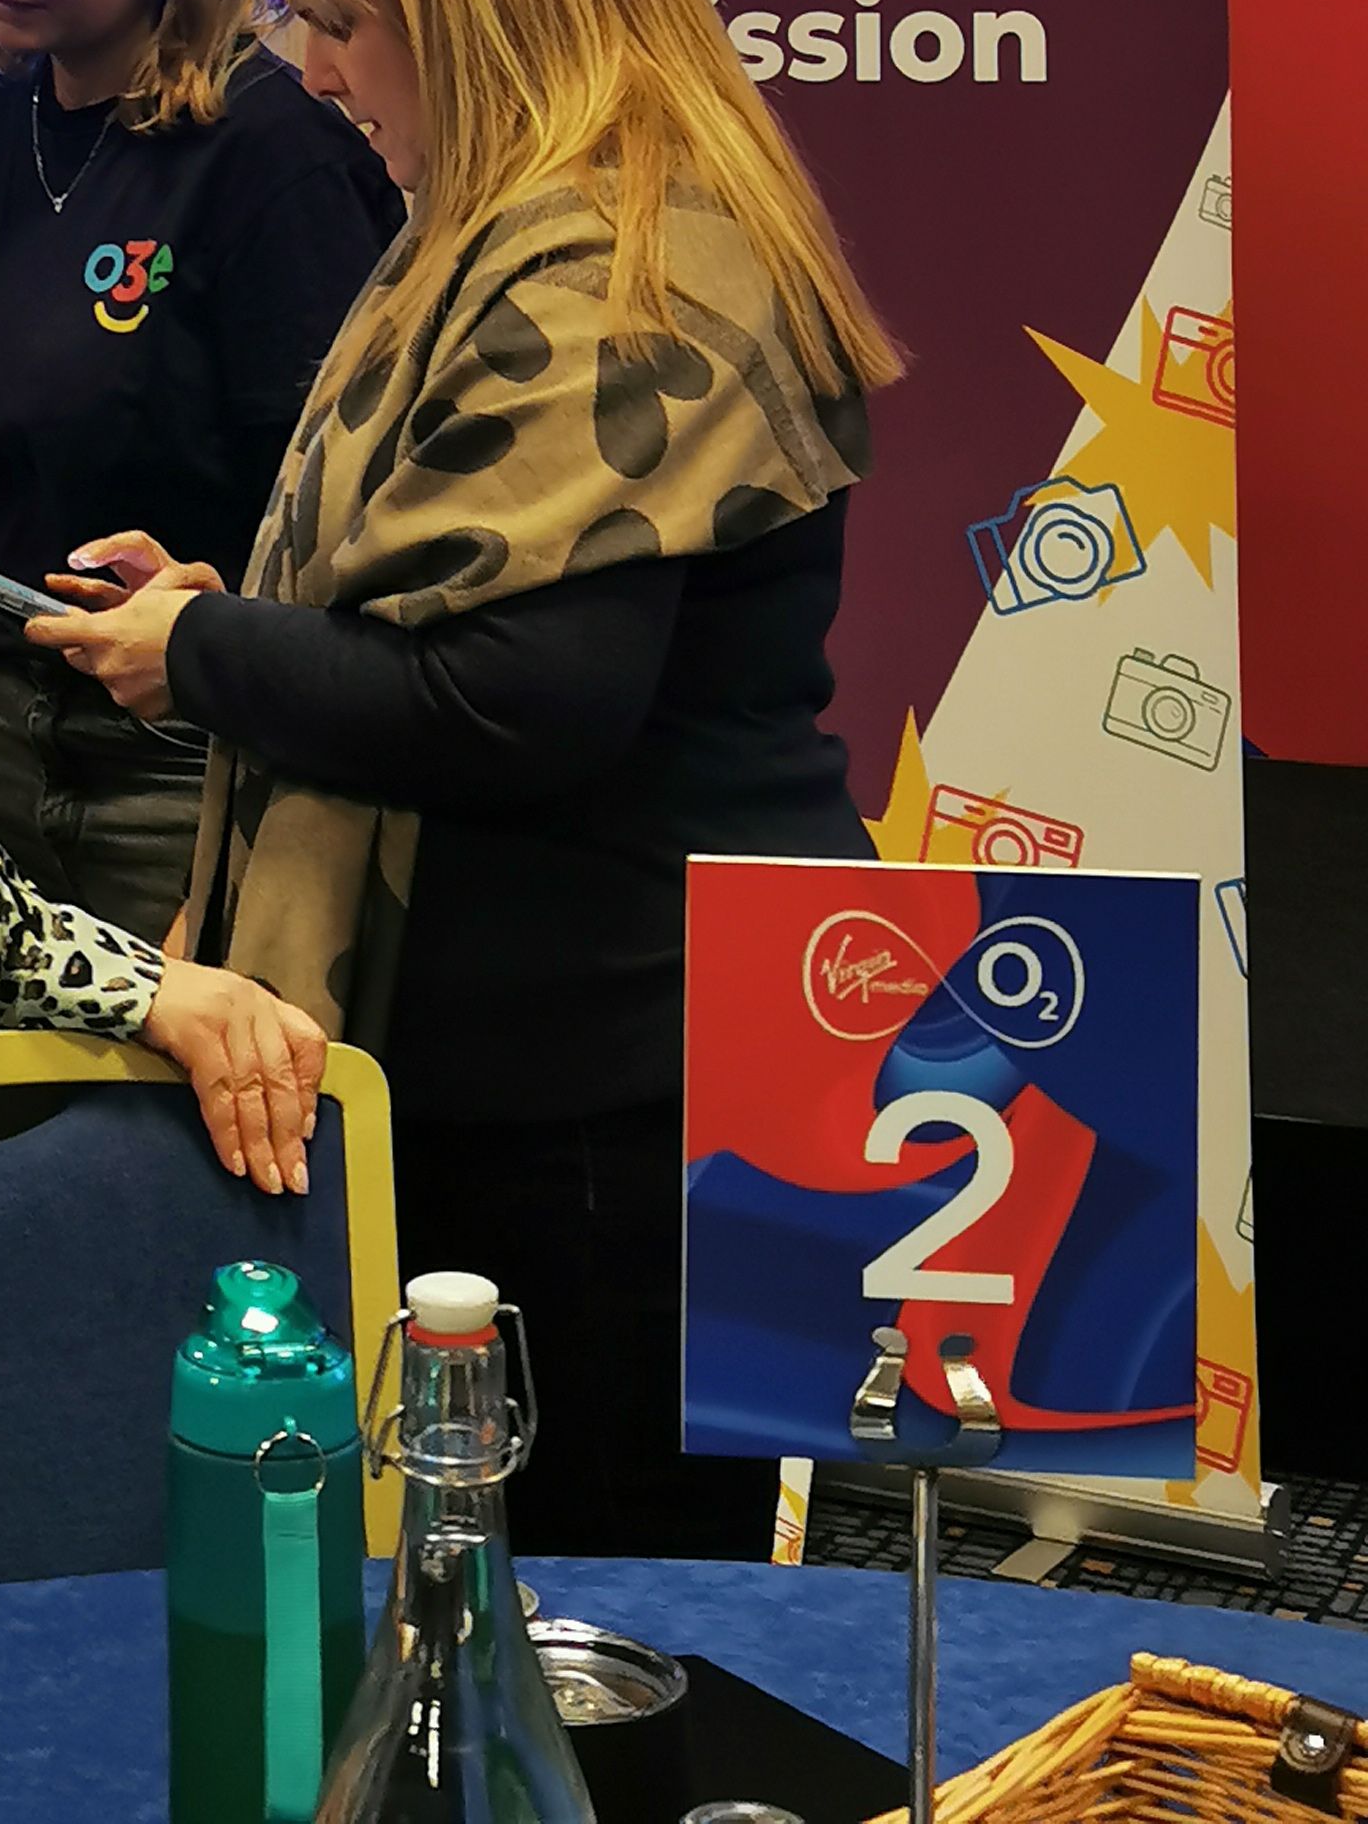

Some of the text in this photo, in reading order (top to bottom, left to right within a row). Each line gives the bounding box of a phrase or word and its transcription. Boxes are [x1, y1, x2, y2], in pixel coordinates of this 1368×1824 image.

[821, 933, 898, 1004] Virgin
[869, 978, 929, 996] media
[862, 1089, 1015, 1305] 2
